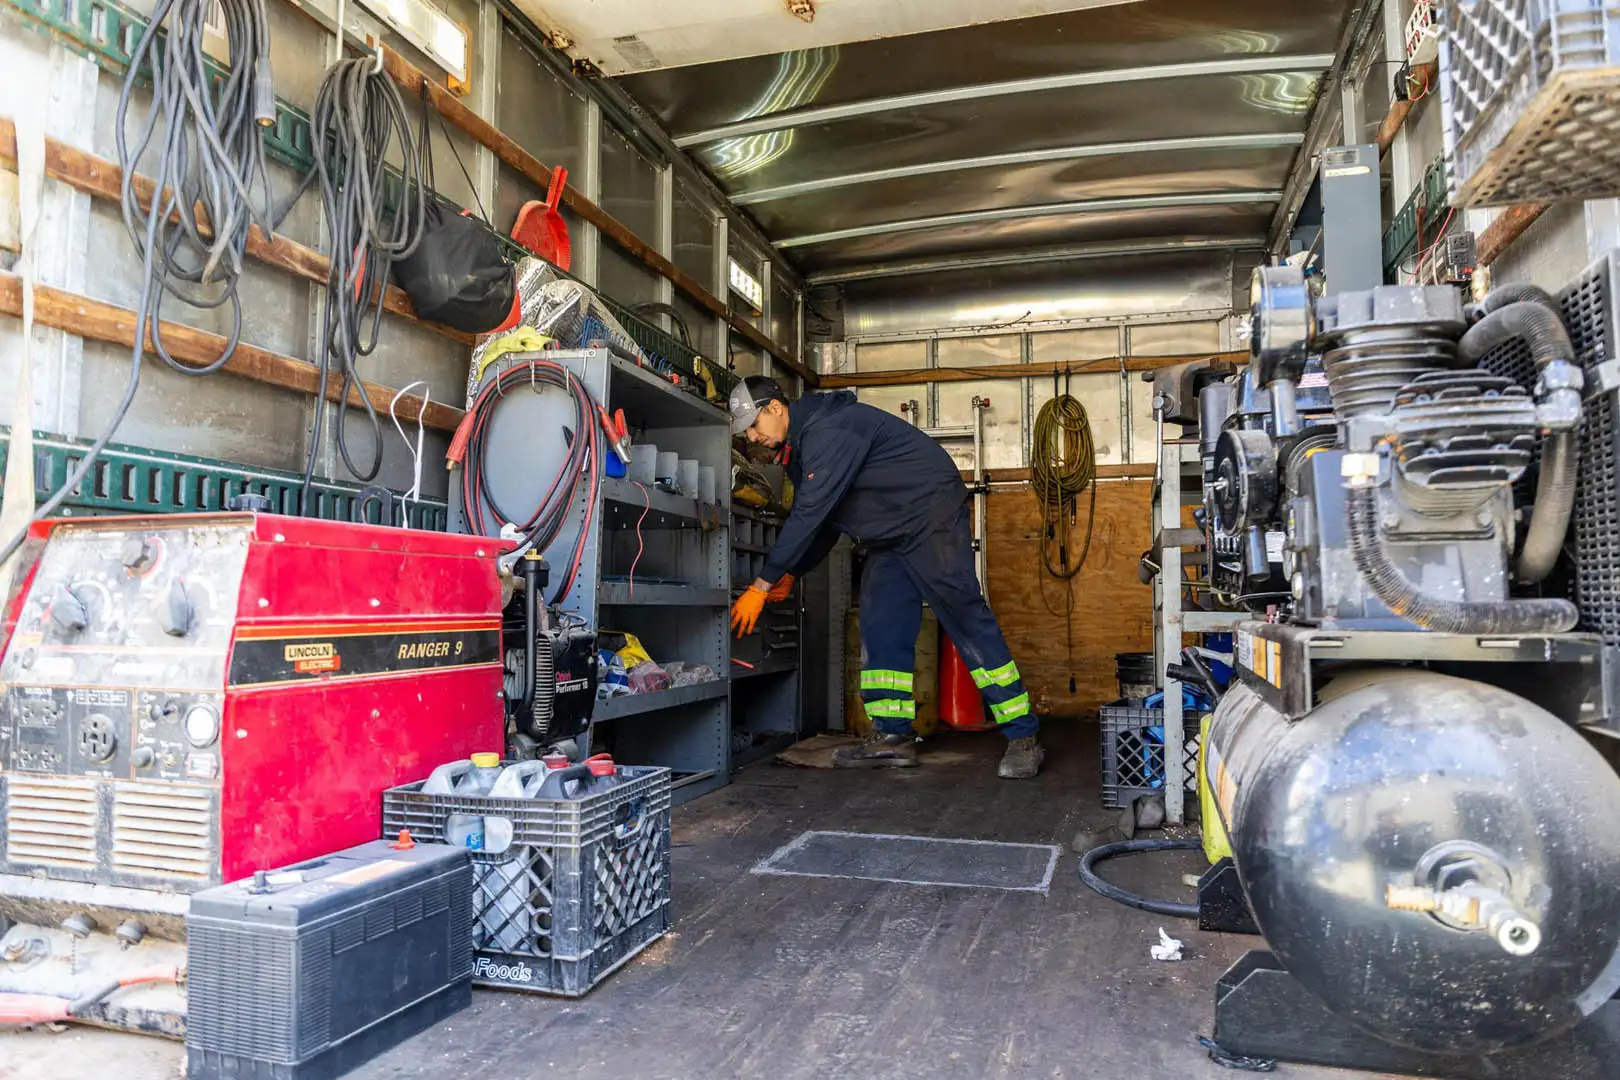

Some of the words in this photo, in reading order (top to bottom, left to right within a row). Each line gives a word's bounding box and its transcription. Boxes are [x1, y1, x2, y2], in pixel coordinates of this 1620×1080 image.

[288, 646, 331, 659] LINCOLN
[397, 642, 450, 659] RANGER
[454, 640, 463, 656] 9
[472, 957, 532, 981] Foods
